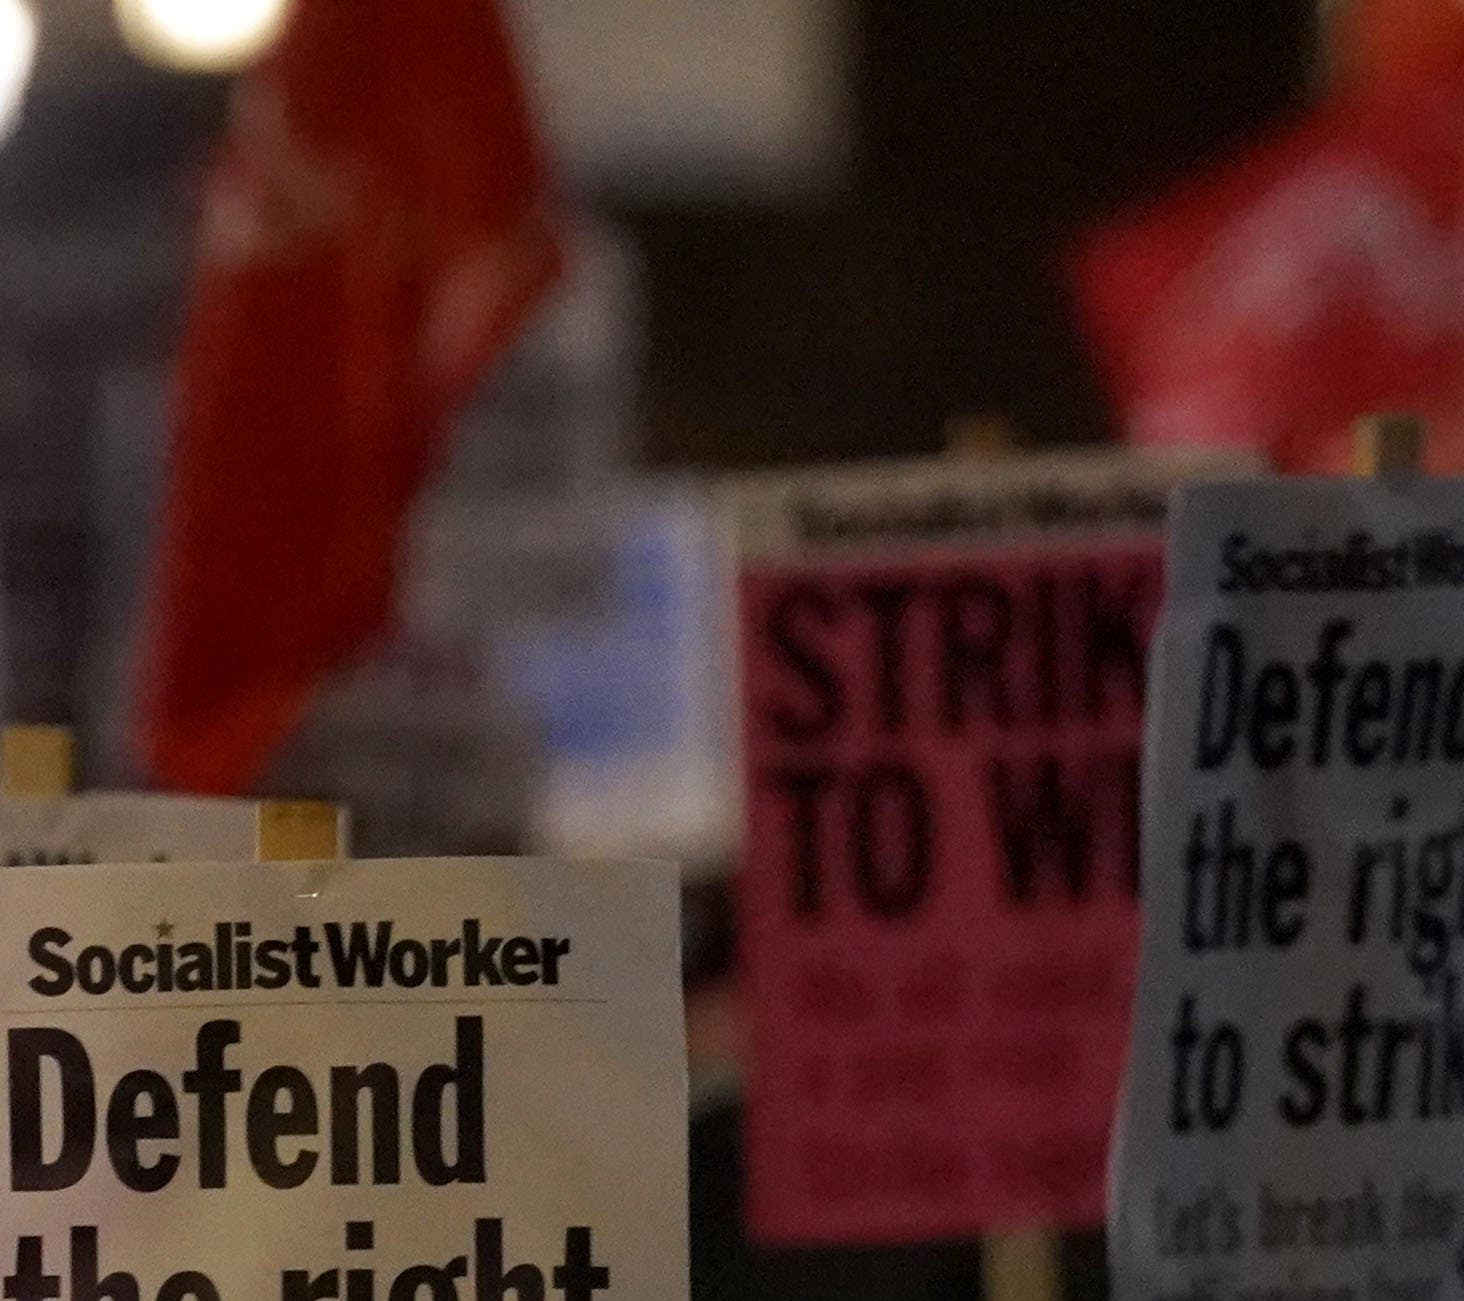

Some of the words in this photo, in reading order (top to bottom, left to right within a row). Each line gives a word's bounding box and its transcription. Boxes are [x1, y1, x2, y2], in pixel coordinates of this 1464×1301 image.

[753, 759, 936, 920] TO
[1182, 799, 1310, 953] the
[6, 1014, 489, 1193] Defend
[1169, 991, 1245, 1134] to
